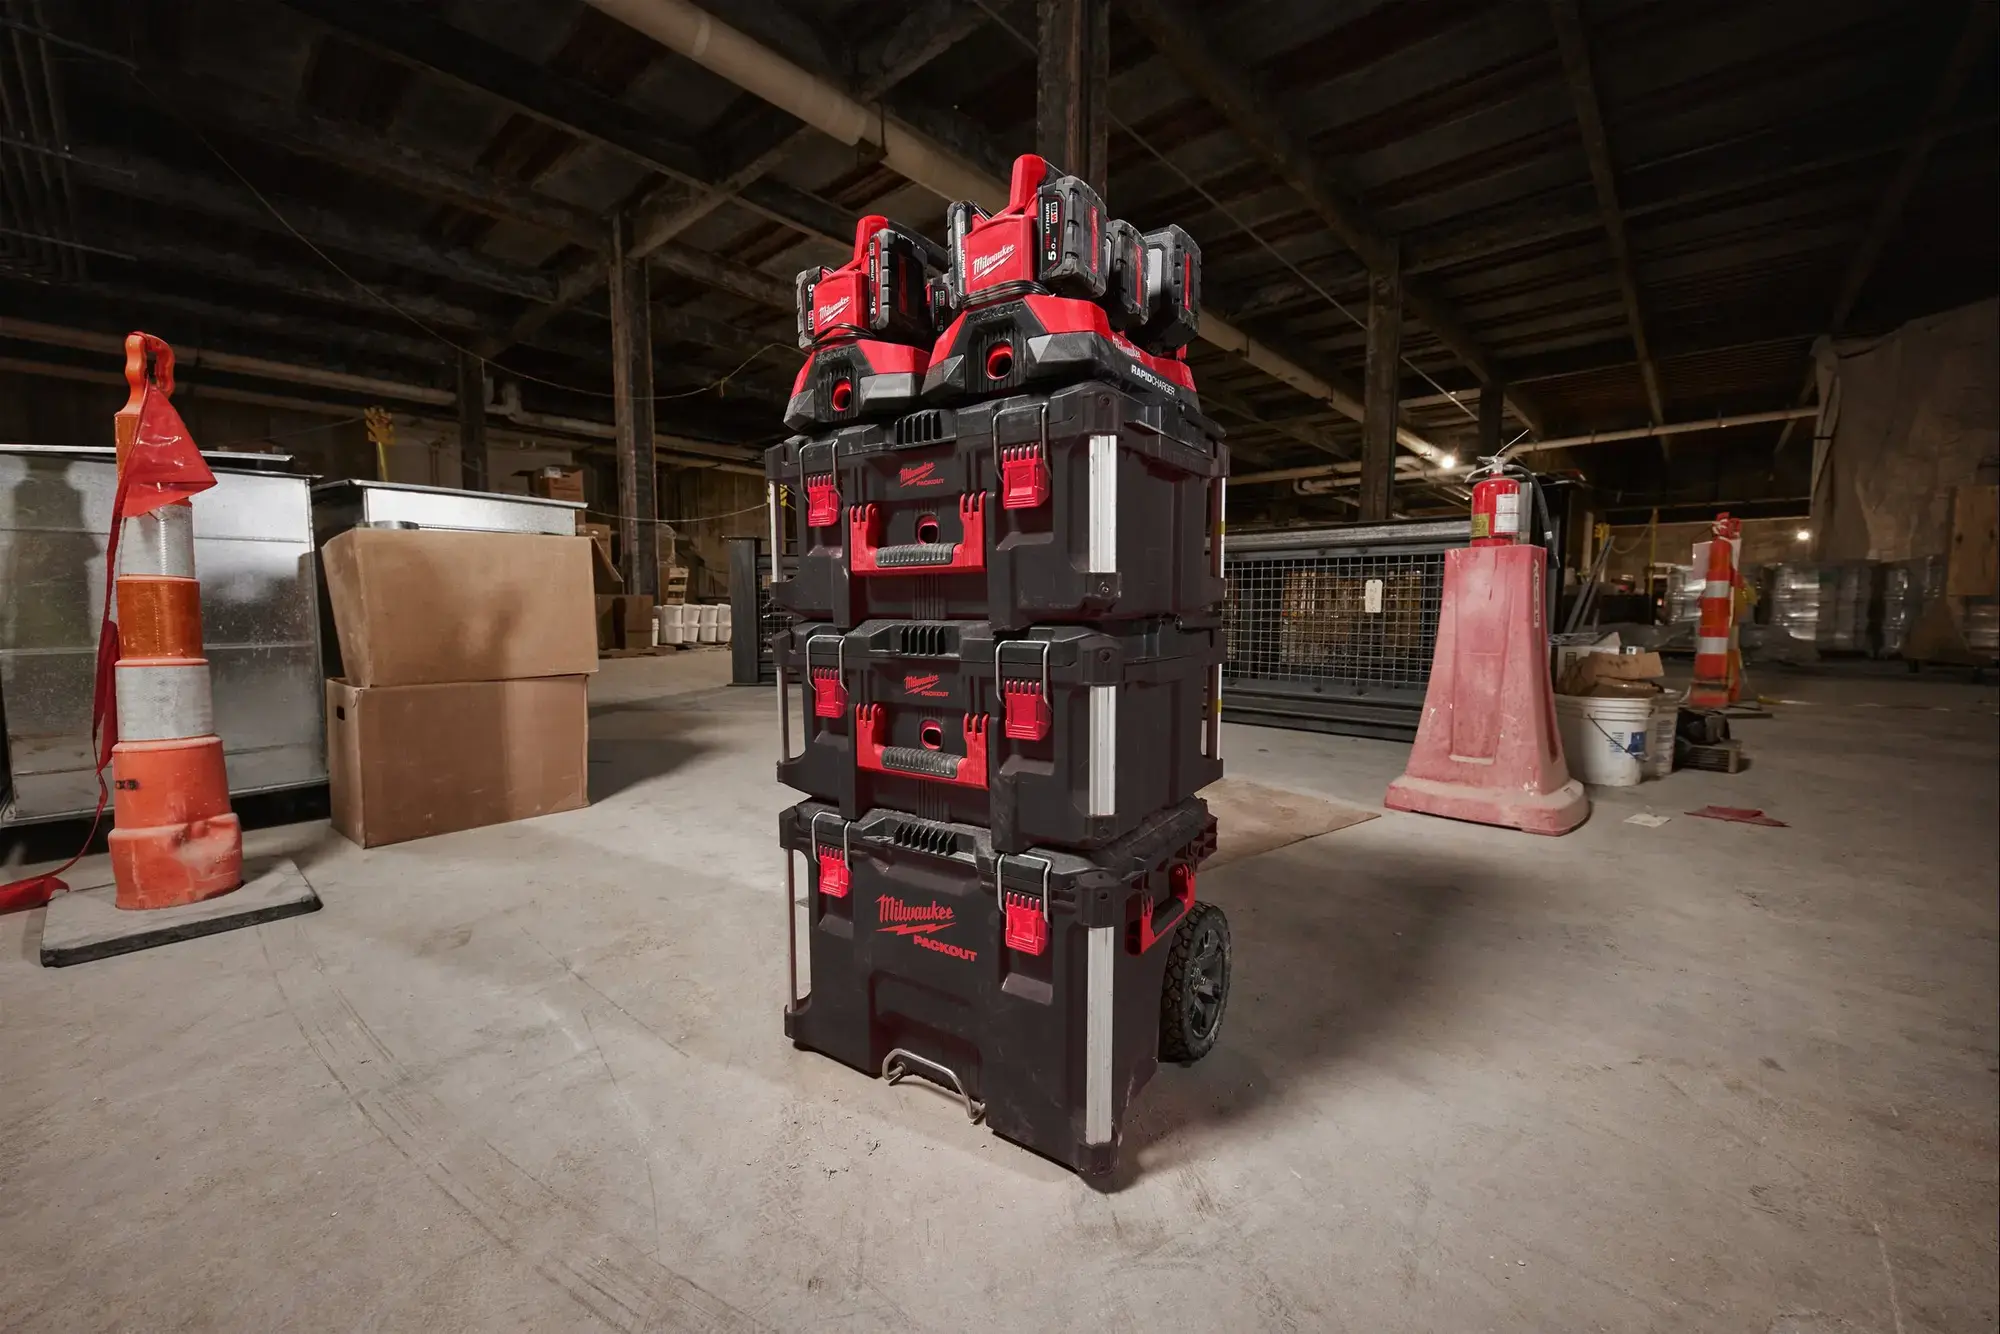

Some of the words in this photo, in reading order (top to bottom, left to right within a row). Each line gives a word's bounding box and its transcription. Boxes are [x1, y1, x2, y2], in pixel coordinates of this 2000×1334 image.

[1050, 201, 1058, 224] M18
[972, 244, 1016, 275] Milwaukee
[819, 296, 851, 321] Milwaukee
[899, 461, 936, 483] Milwaukee
[917, 478, 945, 487] PACKOUT
[904, 673, 940, 690] Milwaukee
[874, 893, 956, 923] Milwaukee
[913, 934, 977, 962] PACKOUT
